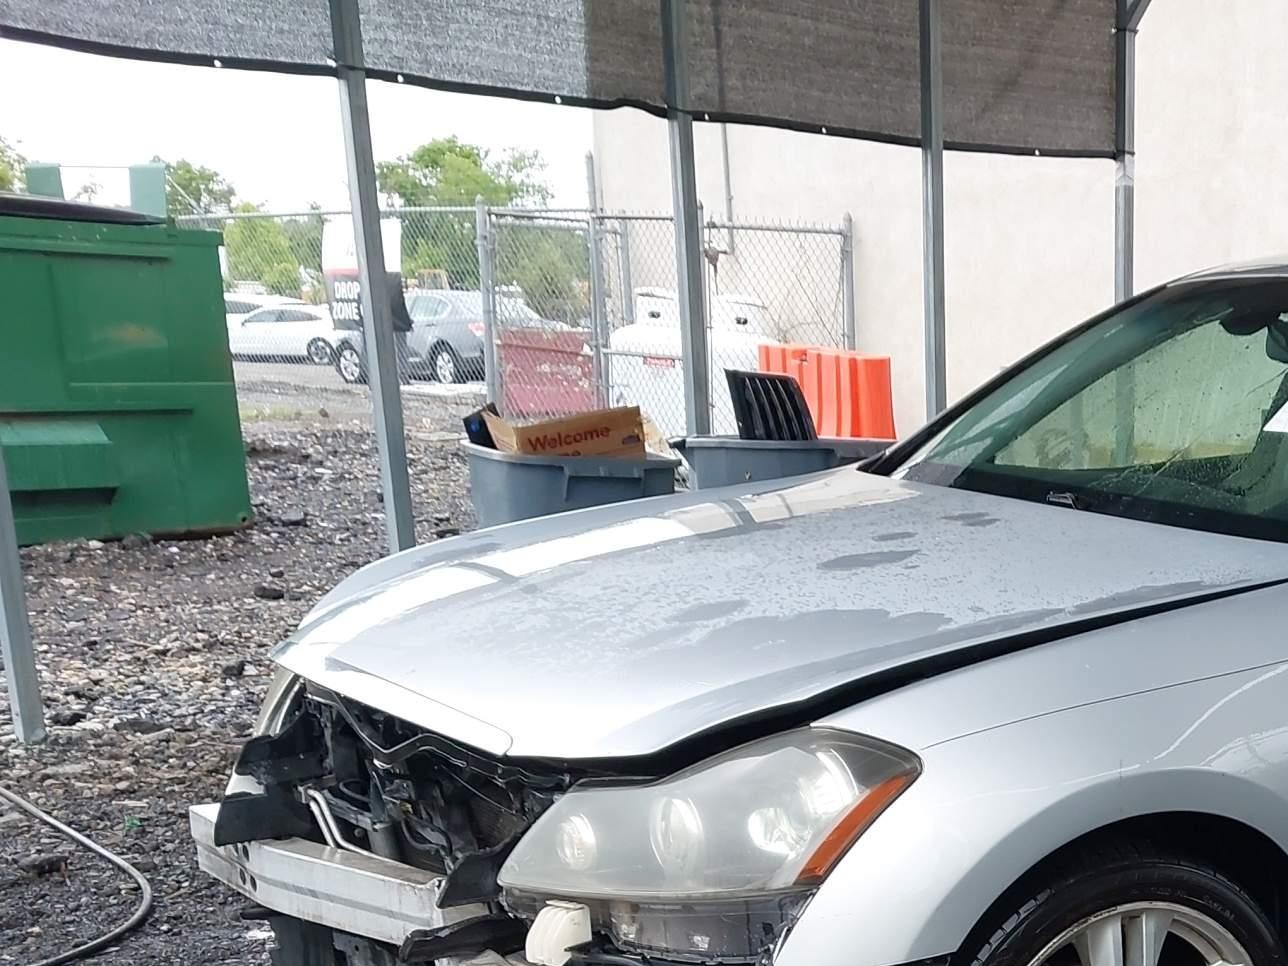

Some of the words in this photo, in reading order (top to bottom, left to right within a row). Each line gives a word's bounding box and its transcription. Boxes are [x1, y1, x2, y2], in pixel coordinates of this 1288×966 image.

[334, 281, 360, 299] DROP
[332, 301, 360, 320] ZONE
[528, 426, 611, 452] Welcome
